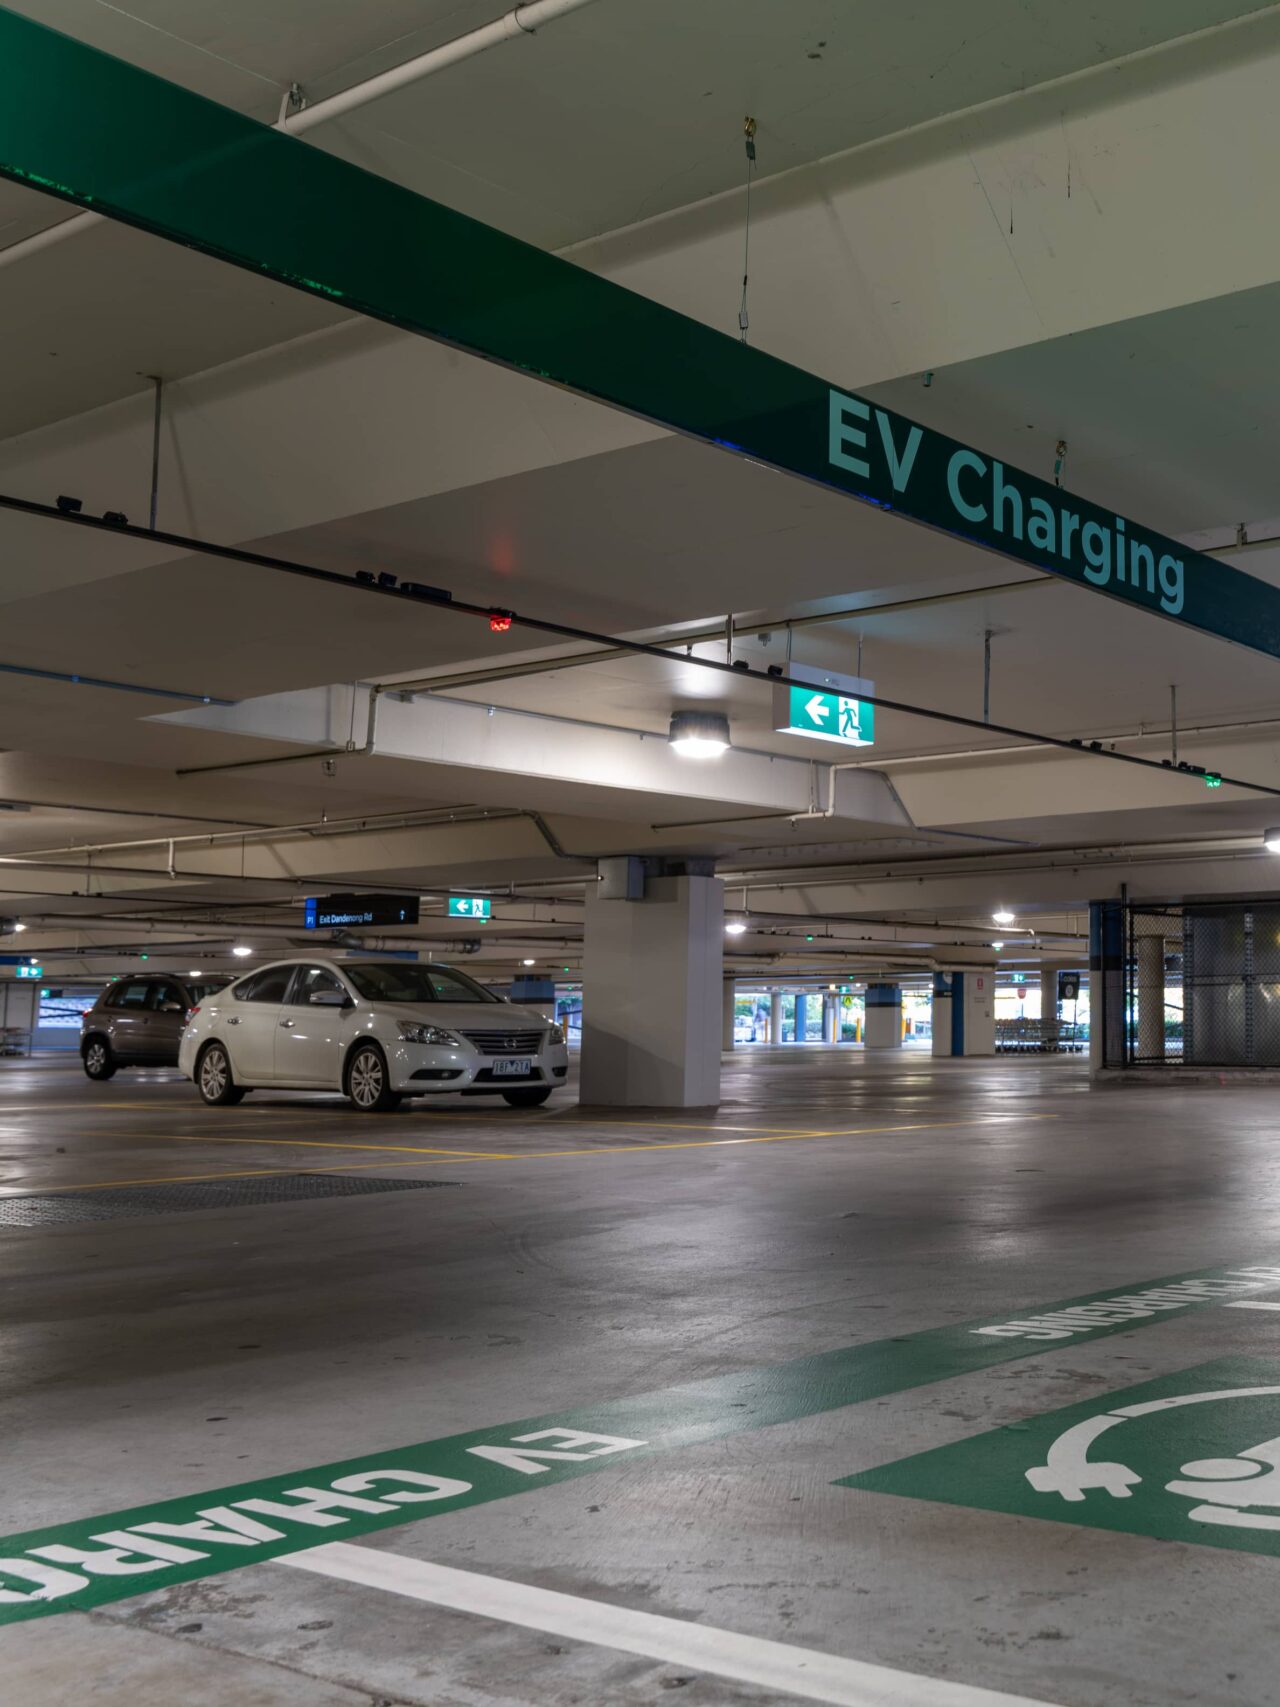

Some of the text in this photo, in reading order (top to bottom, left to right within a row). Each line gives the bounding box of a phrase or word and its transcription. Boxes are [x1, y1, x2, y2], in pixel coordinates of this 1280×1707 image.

[829, 388, 1185, 615] EV Charging
[319, 915, 331, 924] Exit
[331, 914, 363, 923] Dandenong
[364, 912, 373, 921] Rd
[968, 1278, 1266, 1340] CHARGING
[465, 1426, 651, 1475] EV
